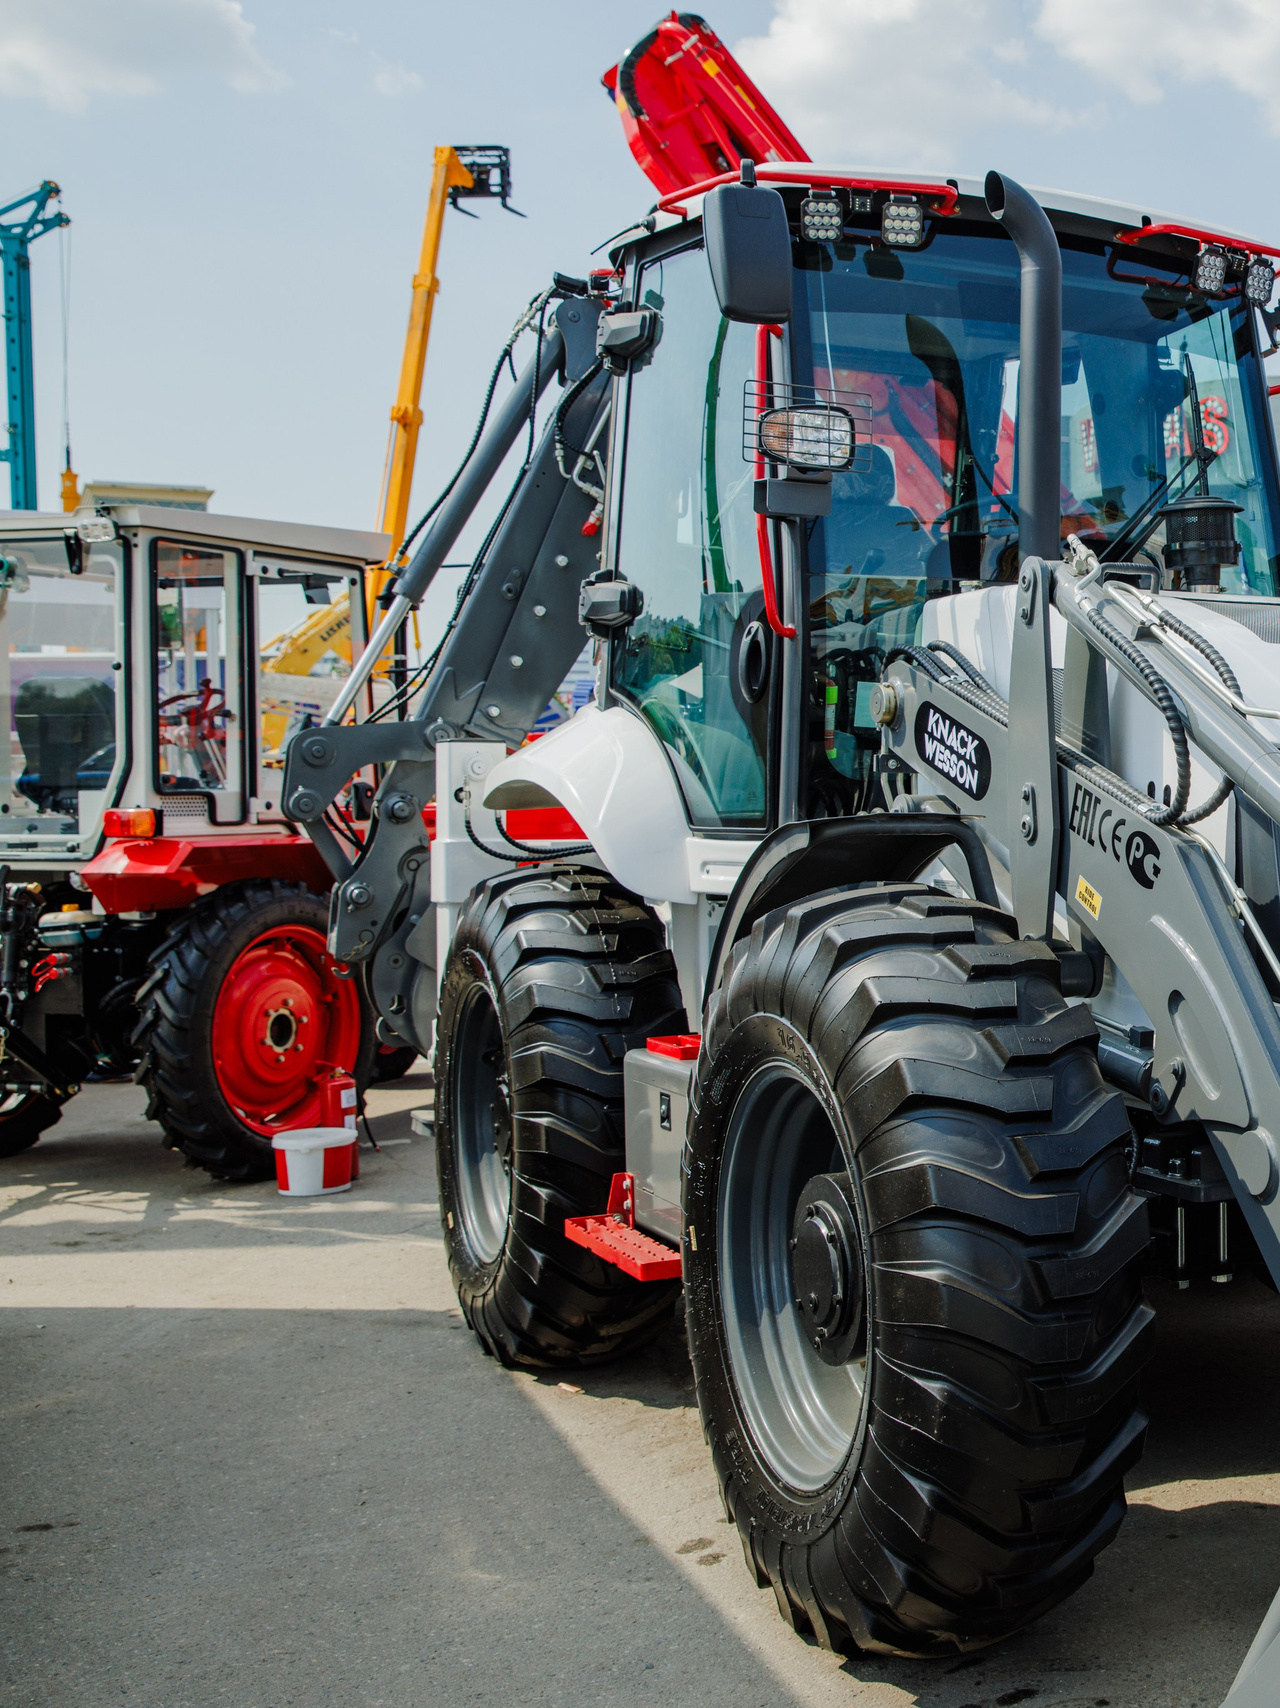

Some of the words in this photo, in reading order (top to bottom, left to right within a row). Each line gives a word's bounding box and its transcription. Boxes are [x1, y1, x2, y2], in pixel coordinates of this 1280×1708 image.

[927, 708, 979, 765] KNACK
[924, 733, 979, 795] WESSON
[1078, 890, 1097, 915] CONTROL
[1084, 885, 1095, 901] RIDE
